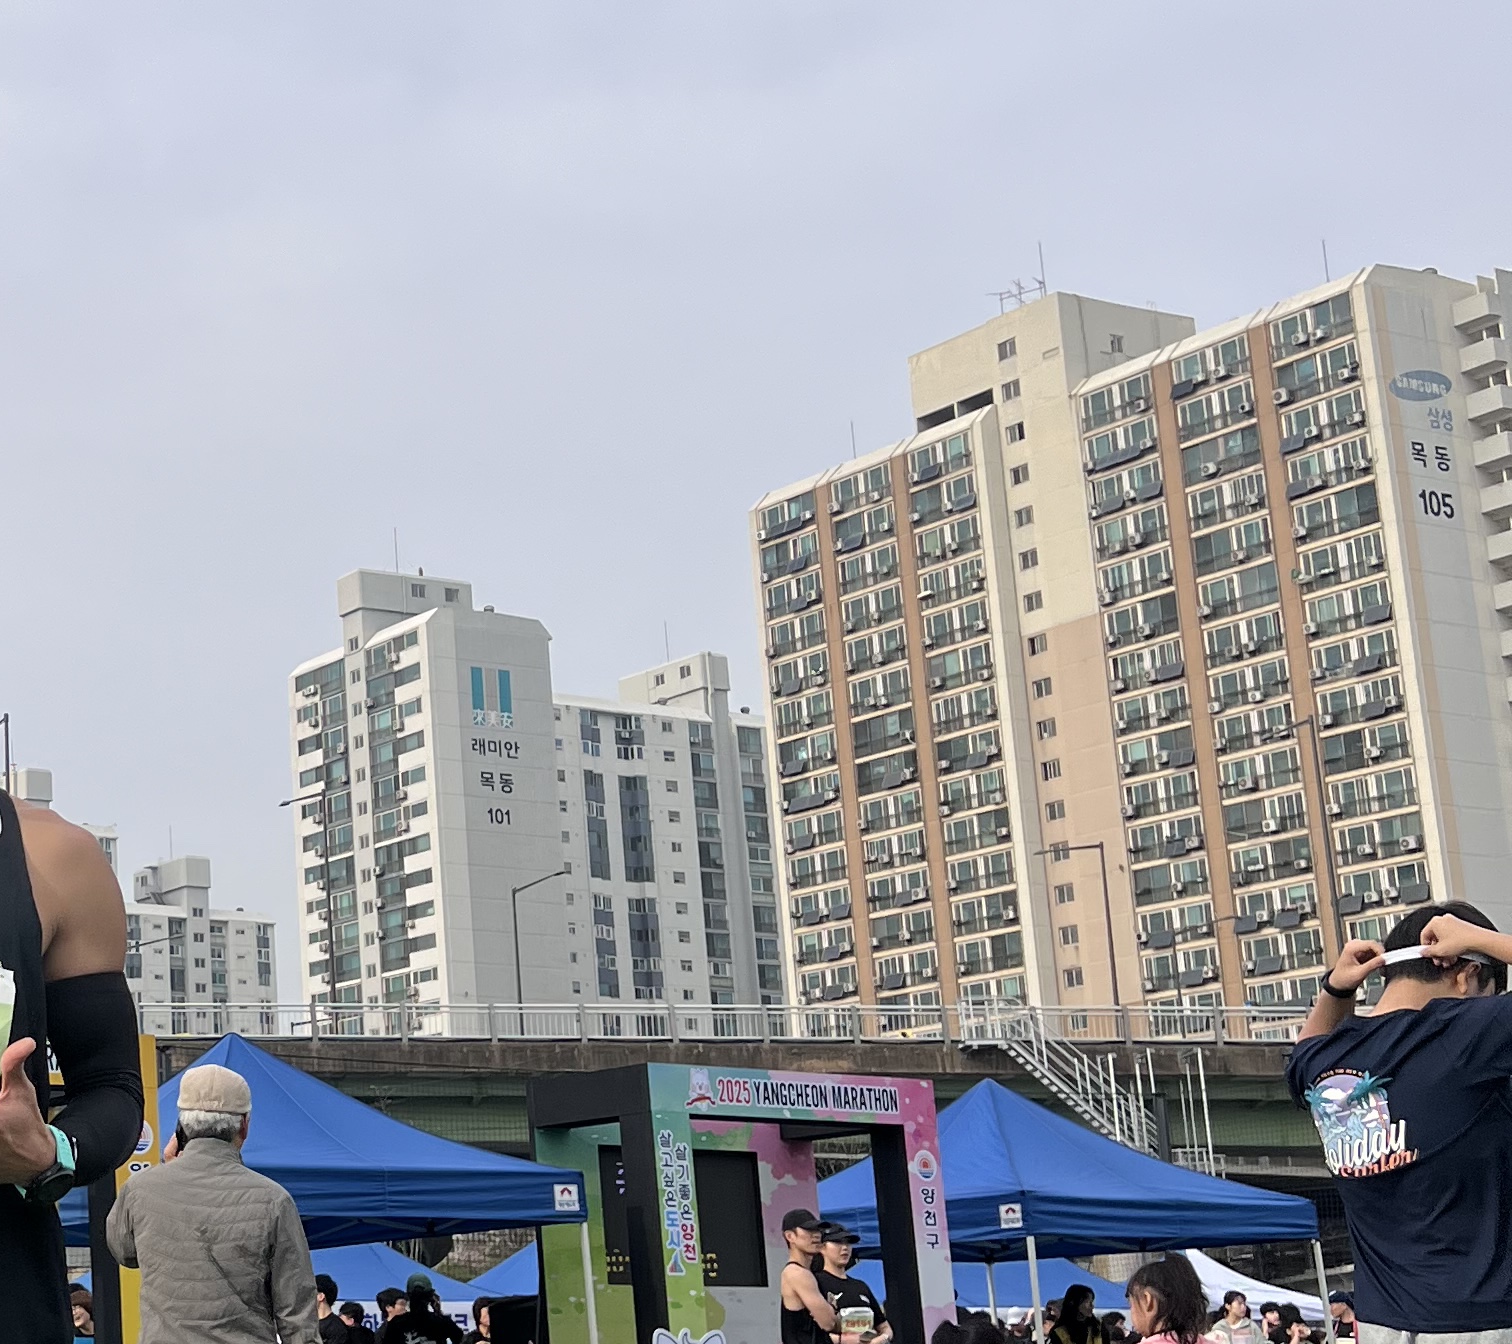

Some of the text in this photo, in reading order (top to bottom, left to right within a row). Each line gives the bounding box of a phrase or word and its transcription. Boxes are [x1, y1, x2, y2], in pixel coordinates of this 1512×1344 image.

[1396, 375, 1447, 396] SAMSUNG
[1427, 407, 1454, 432] 삼성
[1418, 489, 1455, 519] 105
[471, 738, 521, 760] 래미안
[480, 771, 514, 794] 목동
[487, 807, 511, 825] 101
[717, 1078, 900, 1113] 2025 YANGCHEON MARATHON
[1326, 1119, 1407, 1176] oliday
[920, 1187, 940, 1249] 양천구
